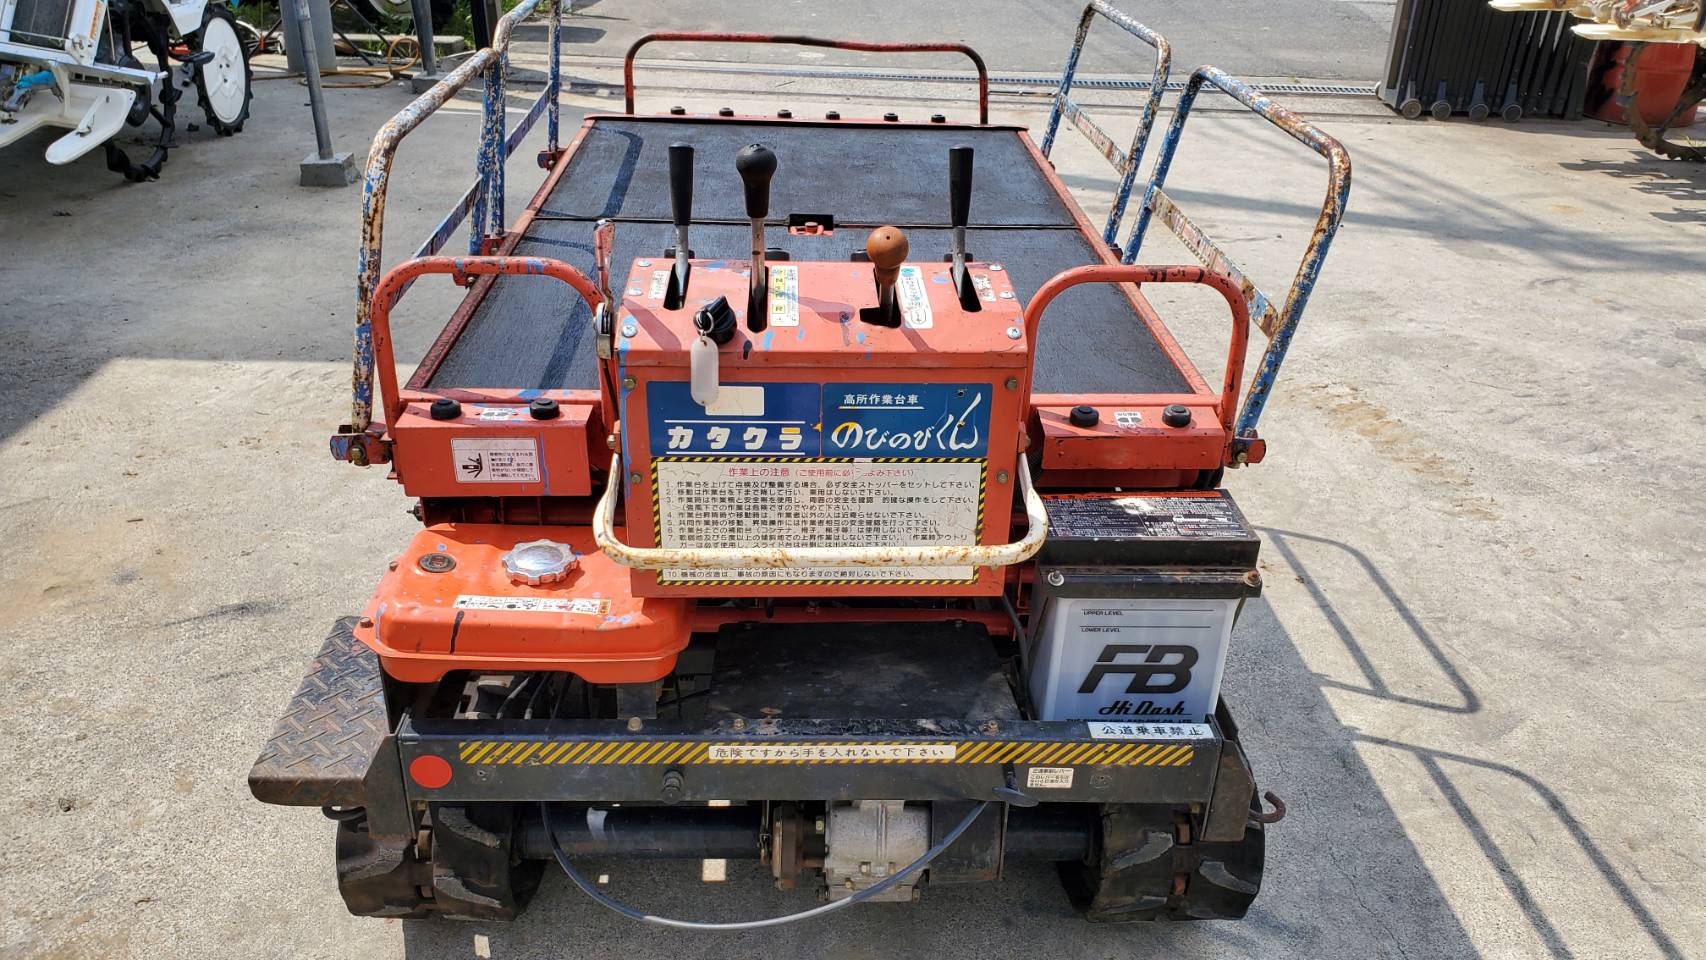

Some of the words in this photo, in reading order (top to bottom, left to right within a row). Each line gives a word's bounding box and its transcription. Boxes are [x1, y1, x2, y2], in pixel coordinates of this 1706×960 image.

[843, 393, 919, 406] 高所作業台車
[831, 392, 982, 452] のびのびくん
[667, 425, 804, 451] カタクラ
[728, 467, 790, 477] 作業上の注意
[1077, 644, 1199, 694] FB
[1098, 700, 1133, 715] Hi
[1133, 700, 1187, 715] Dash
[1102, 725, 1203, 736] 公道乗車禁止
[715, 747, 945, 758] 危険ですから手を入れないで下さい
